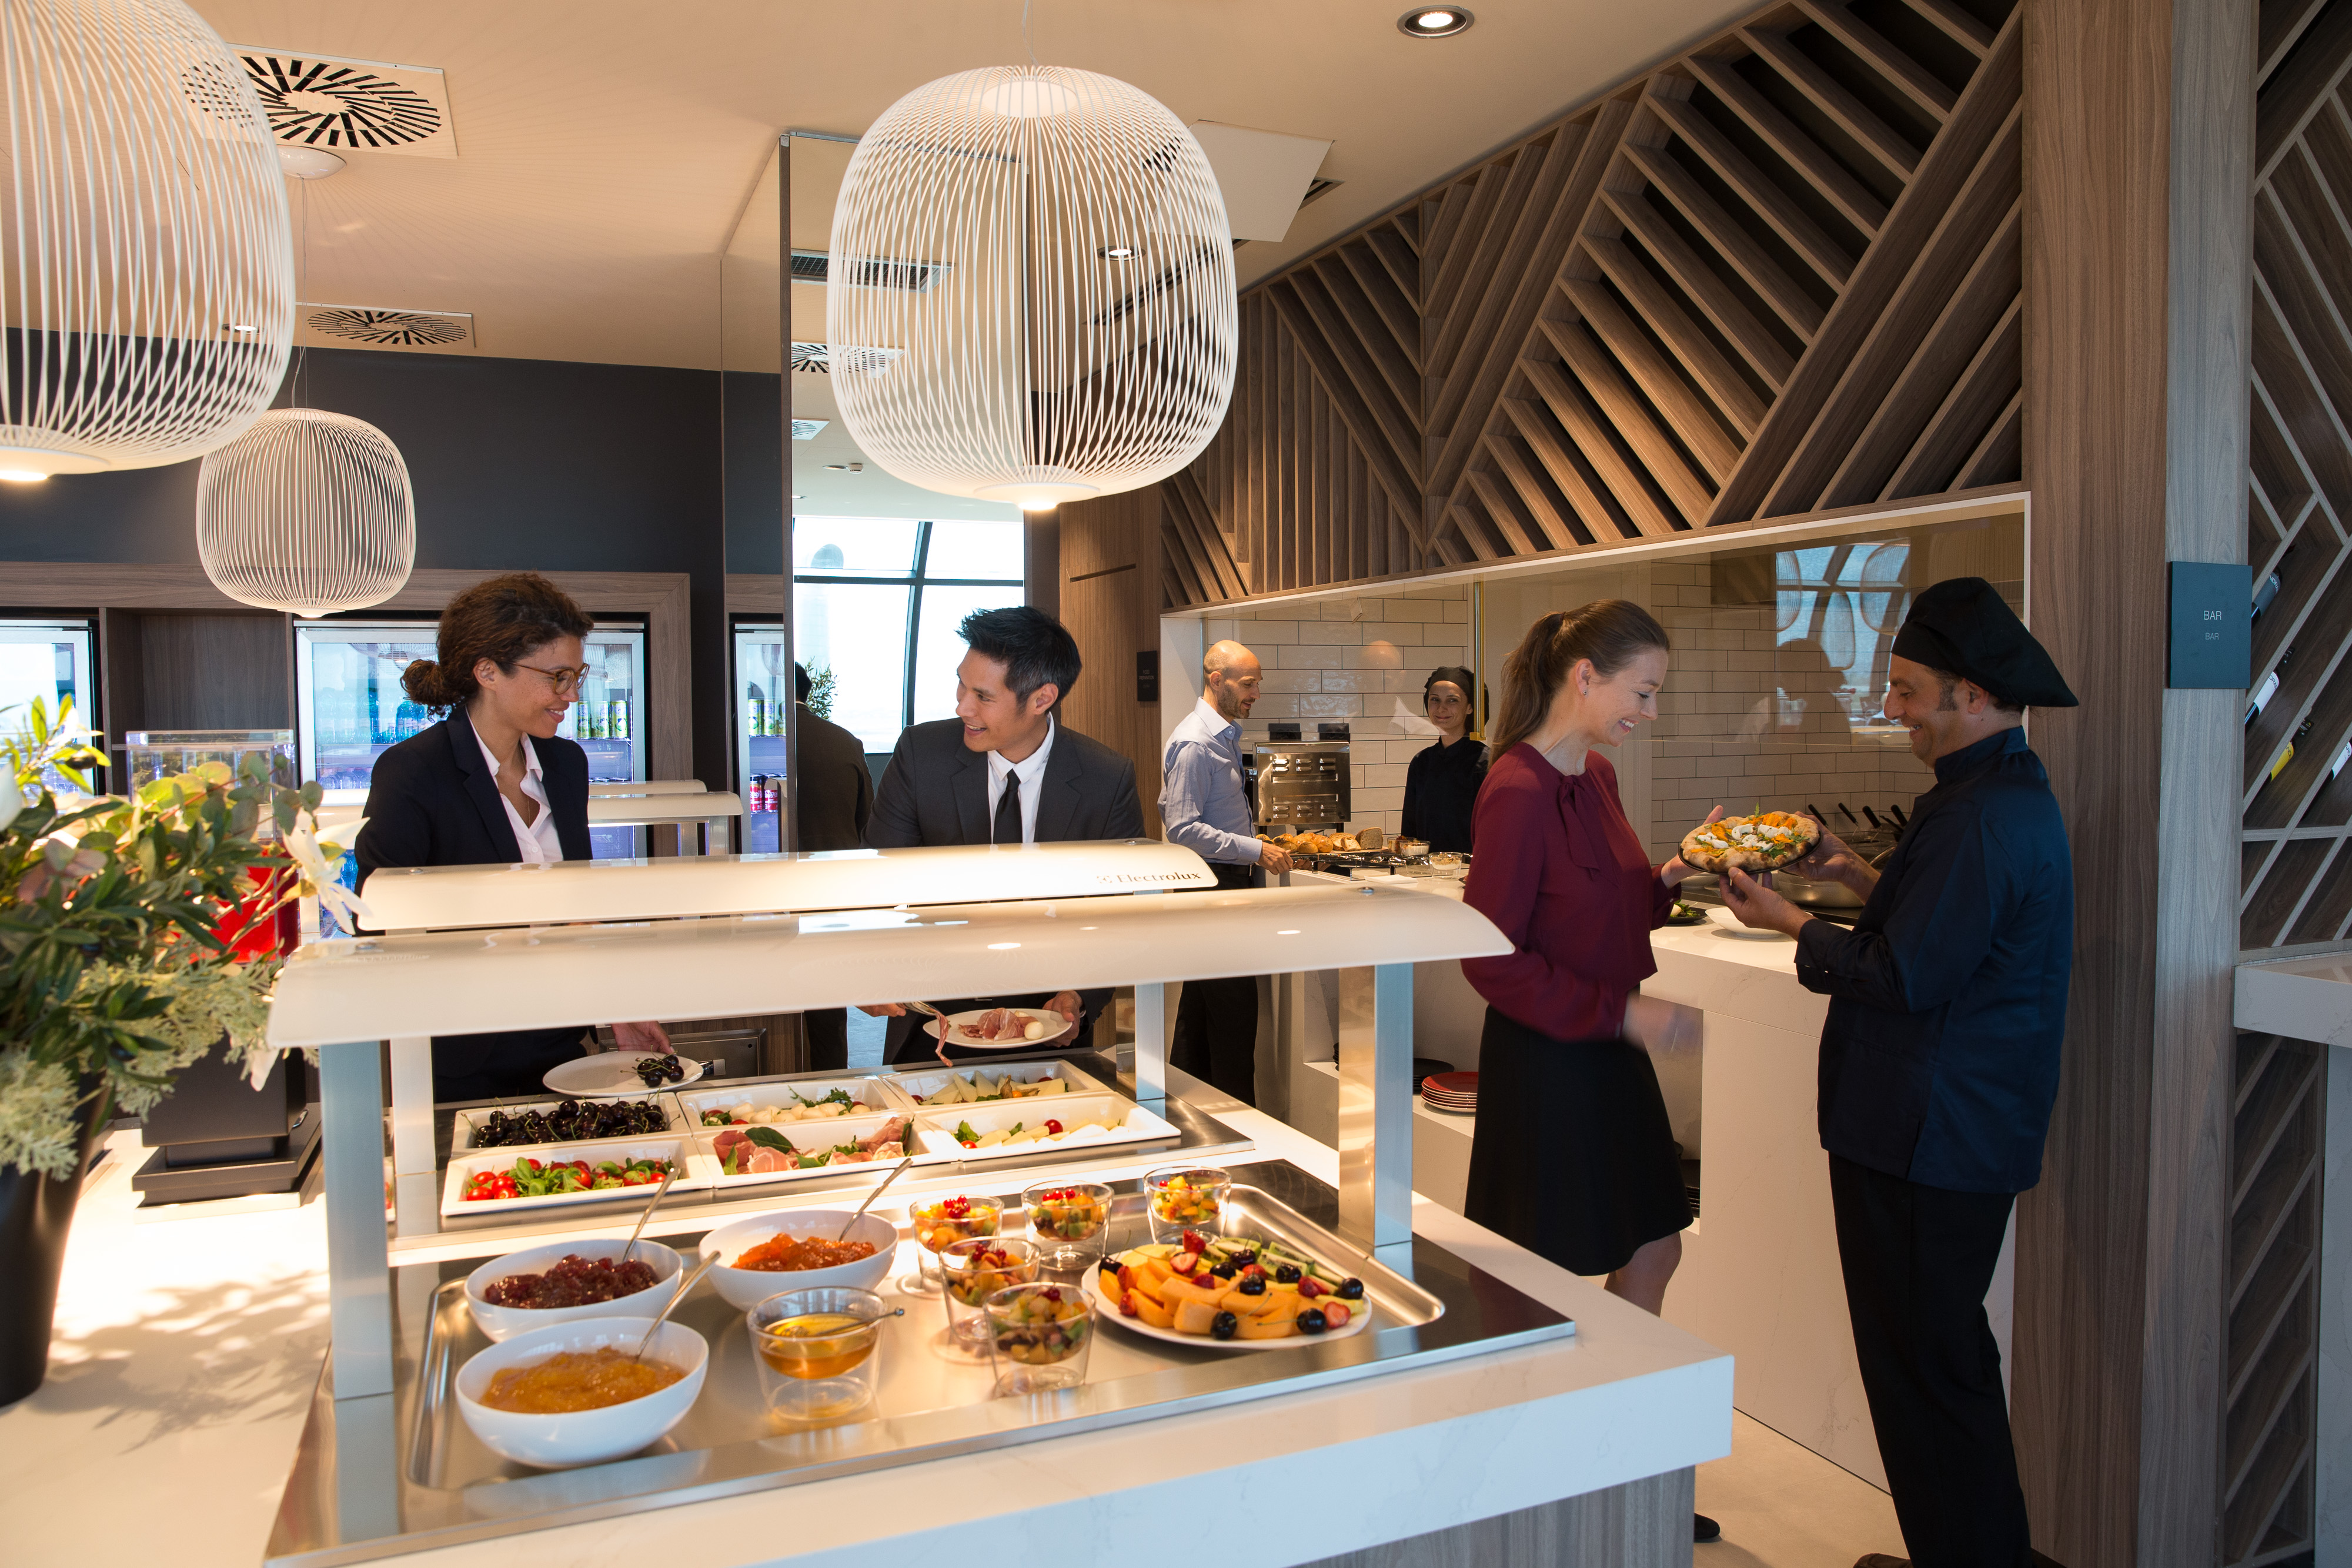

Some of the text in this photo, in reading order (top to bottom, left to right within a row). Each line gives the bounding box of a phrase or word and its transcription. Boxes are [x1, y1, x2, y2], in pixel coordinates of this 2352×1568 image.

[2203, 610, 2221, 620] BAR
[2205, 632, 2219, 640] BAR
[1117, 872, 1202, 882] Electrolux
